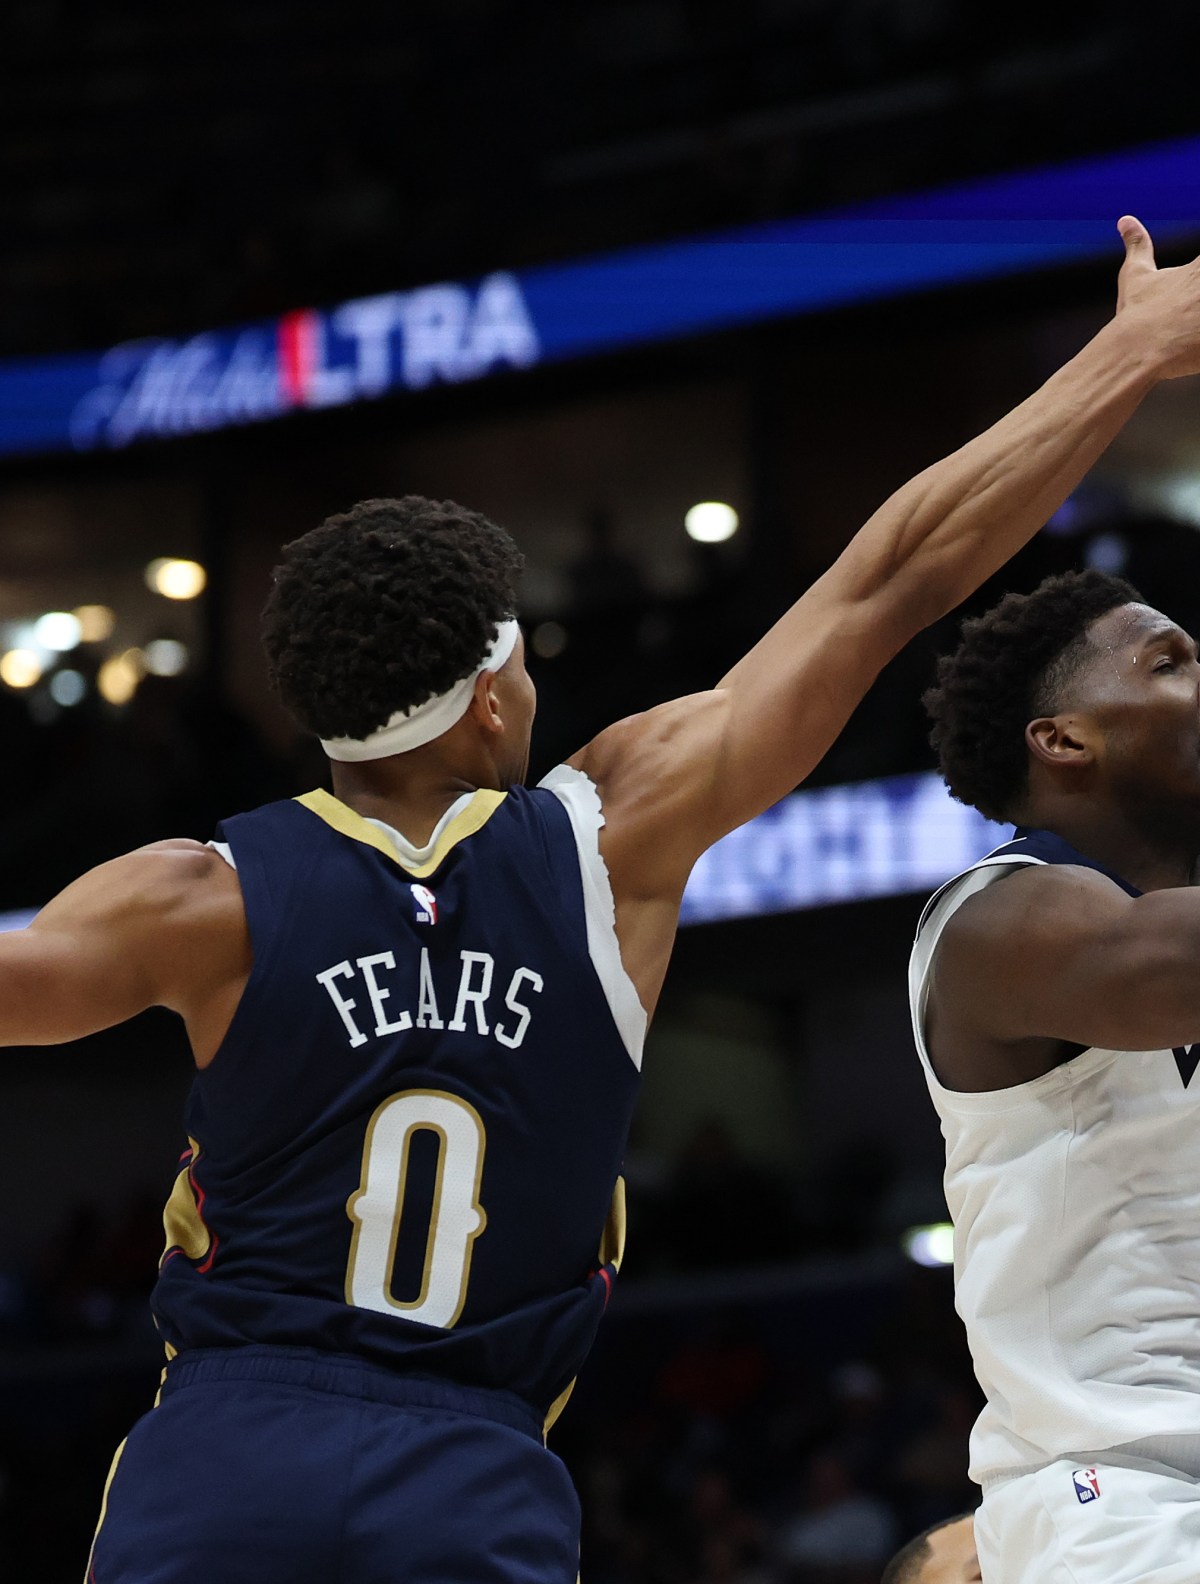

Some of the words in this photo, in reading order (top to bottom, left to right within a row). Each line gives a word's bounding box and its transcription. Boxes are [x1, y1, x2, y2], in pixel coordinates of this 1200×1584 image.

[316, 947, 544, 1049] FEARS
[345, 1088, 486, 1329] 0
[1079, 1489, 1093, 1502] NBA
